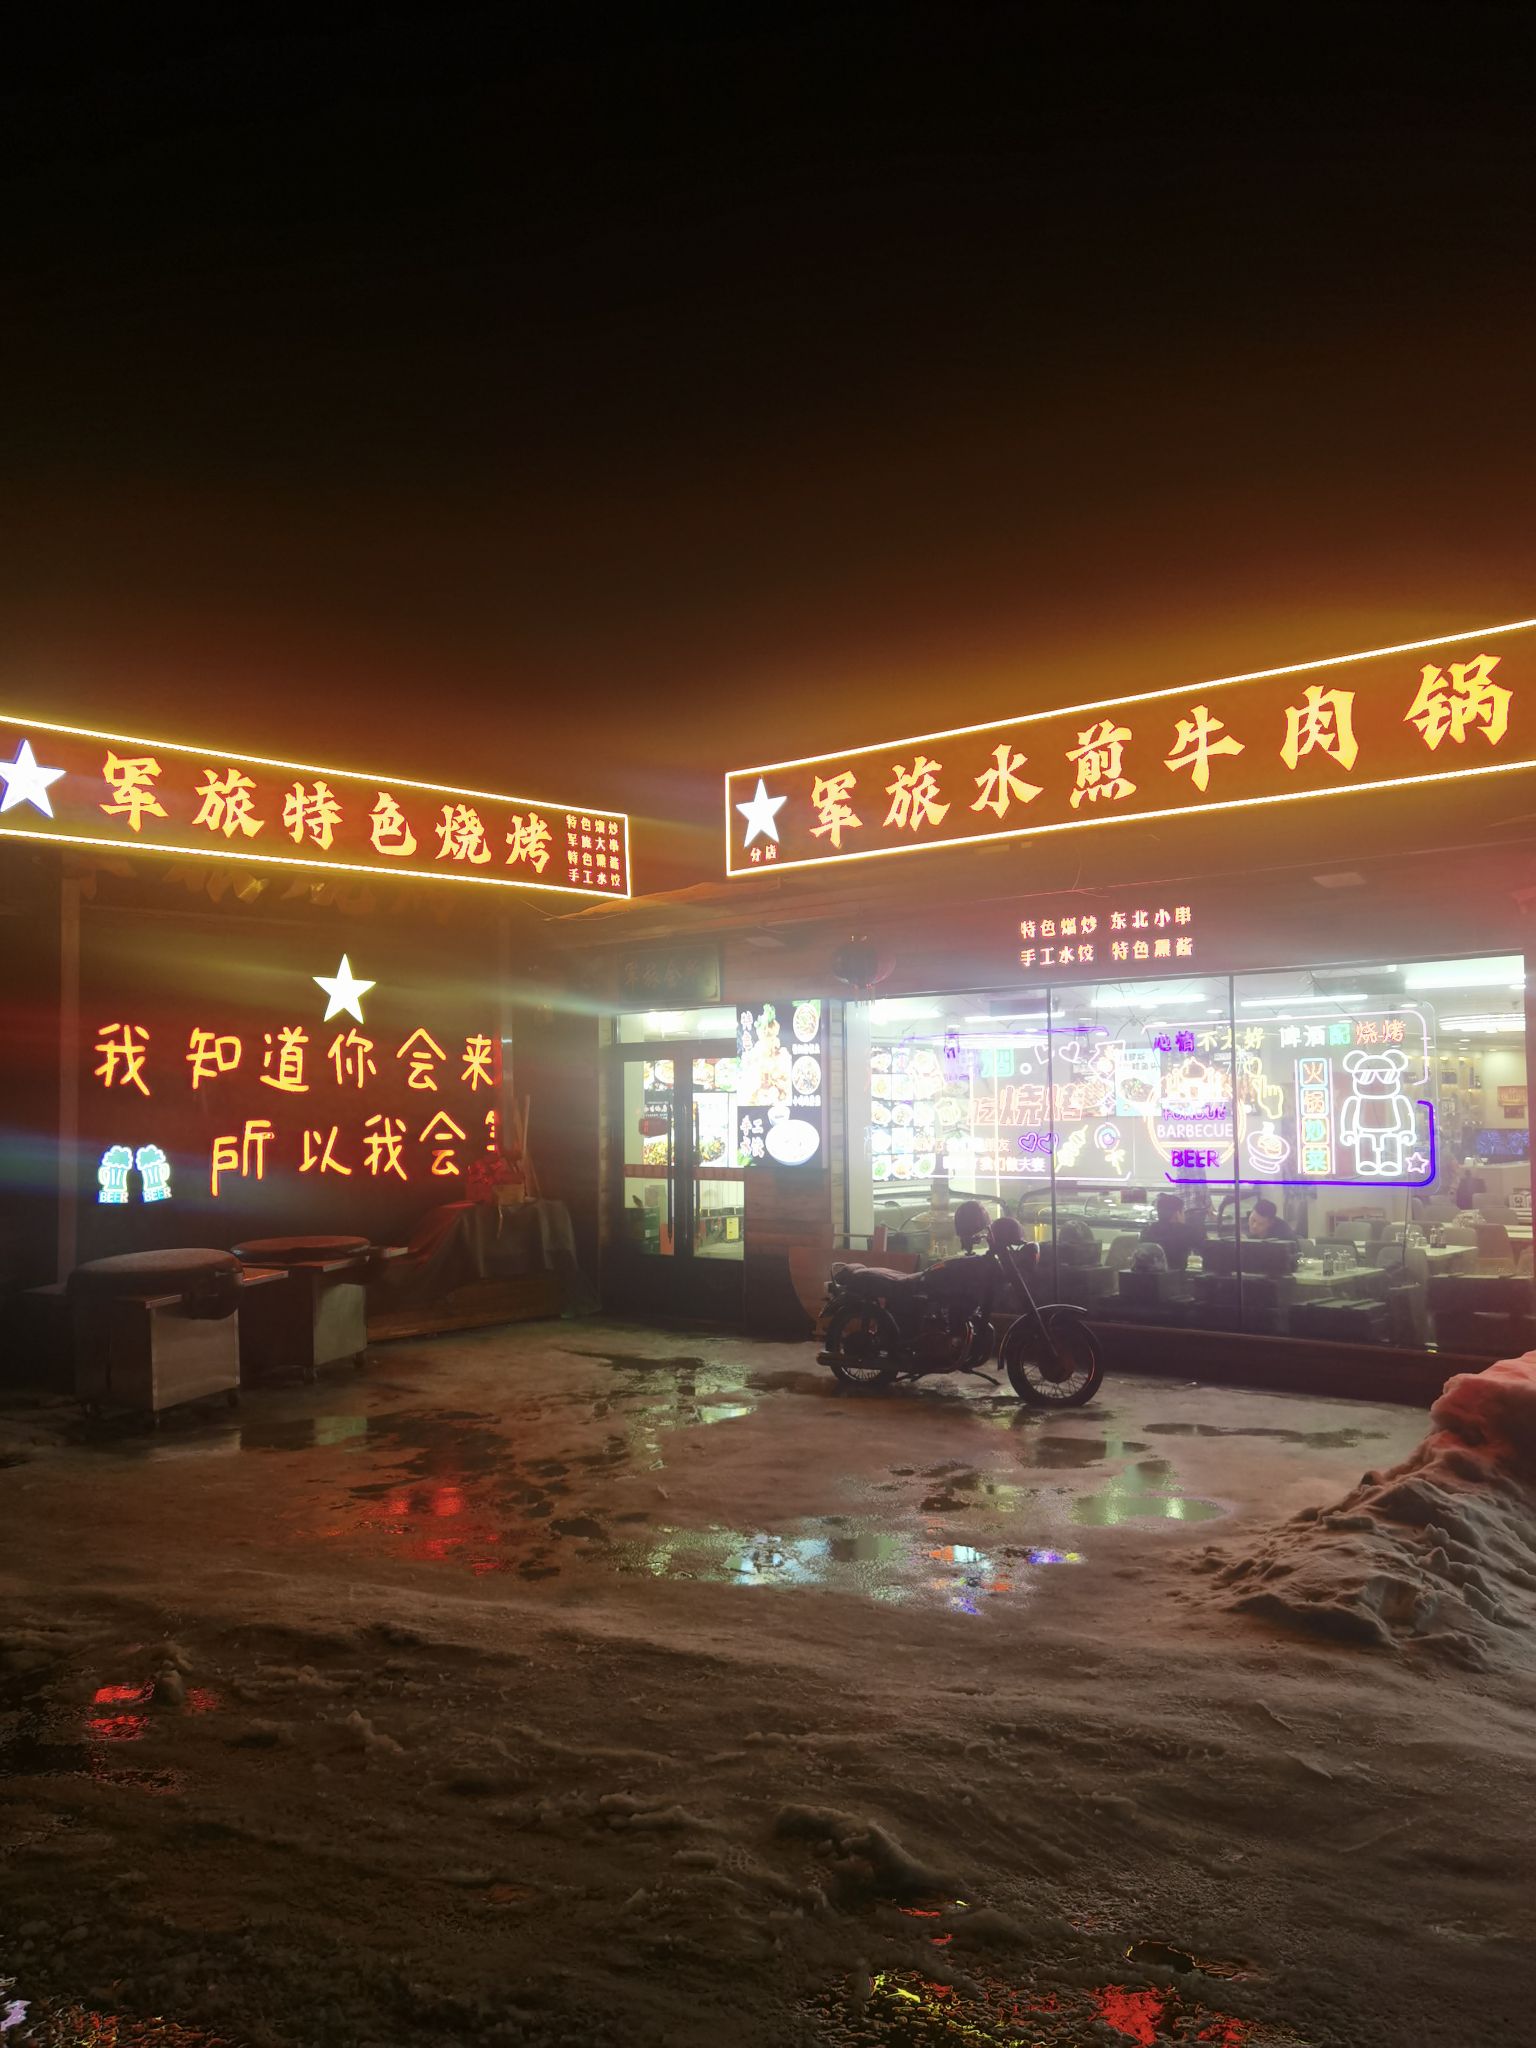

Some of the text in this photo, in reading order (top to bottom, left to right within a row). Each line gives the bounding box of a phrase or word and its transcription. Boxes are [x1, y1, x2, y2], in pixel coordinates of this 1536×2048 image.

[809, 653, 1514, 849] 军旅水煎牛肉锅
[99, 750, 554, 874] 军旅特色烧烤
[750, 844, 777, 862] 分店
[1110, 906, 1192, 930] 东北小串
[1020, 944, 1095, 967] 手工水饺
[94, 1023, 495, 1096] 我知道你会来
[1157, 1123, 1233, 1139] BARBECUE
[1171, 1149, 1220, 1169] BEER
[99, 1190, 129, 1203] BEER
[143, 1186, 173, 1203] BEER
